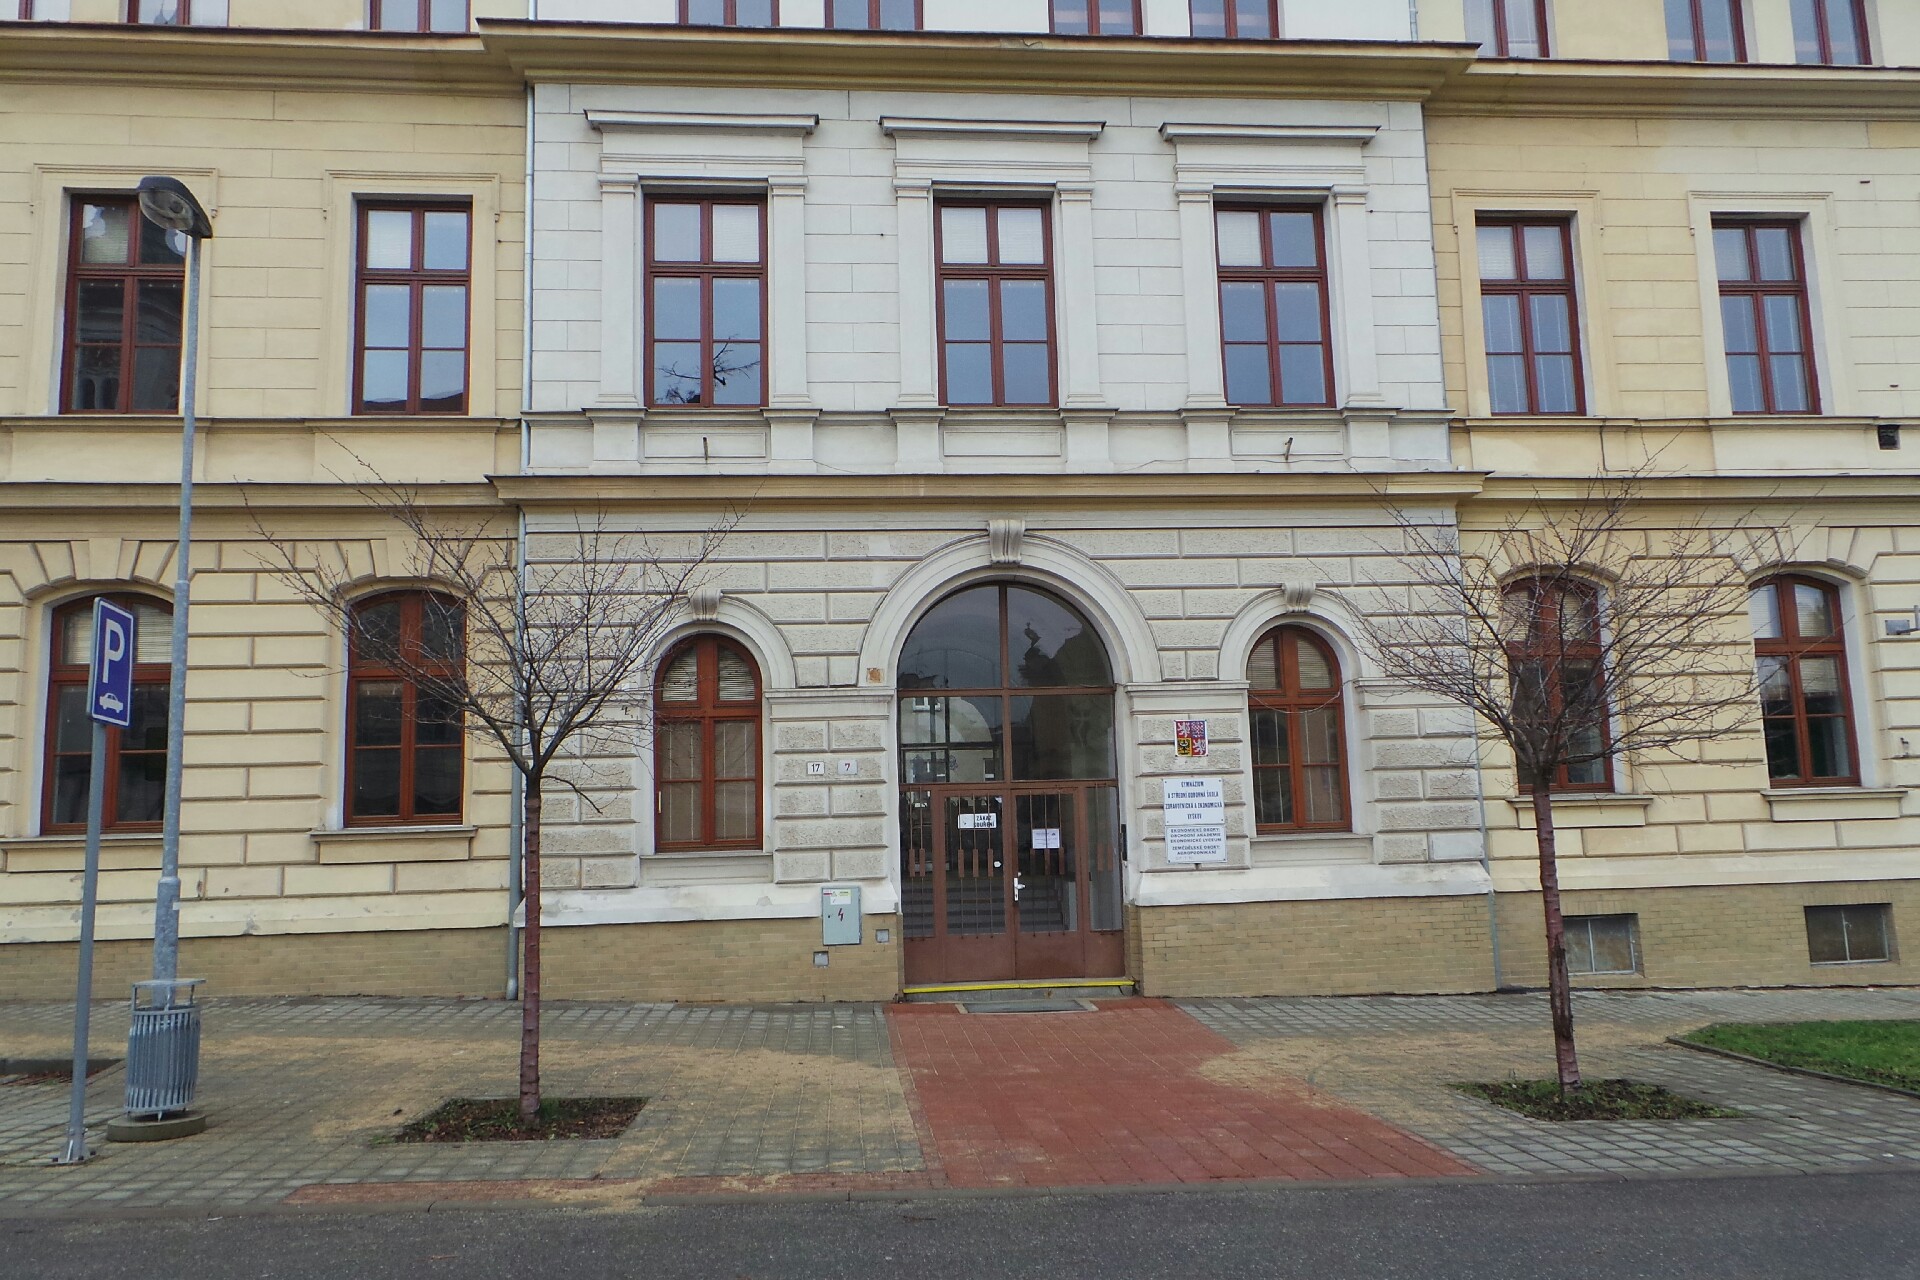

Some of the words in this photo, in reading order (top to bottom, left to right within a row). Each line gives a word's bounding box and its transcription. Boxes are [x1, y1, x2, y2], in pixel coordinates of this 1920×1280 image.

[102, 618, 125, 684] P
[812, 764, 820, 772] 17
[844, 762, 850, 771] 7
